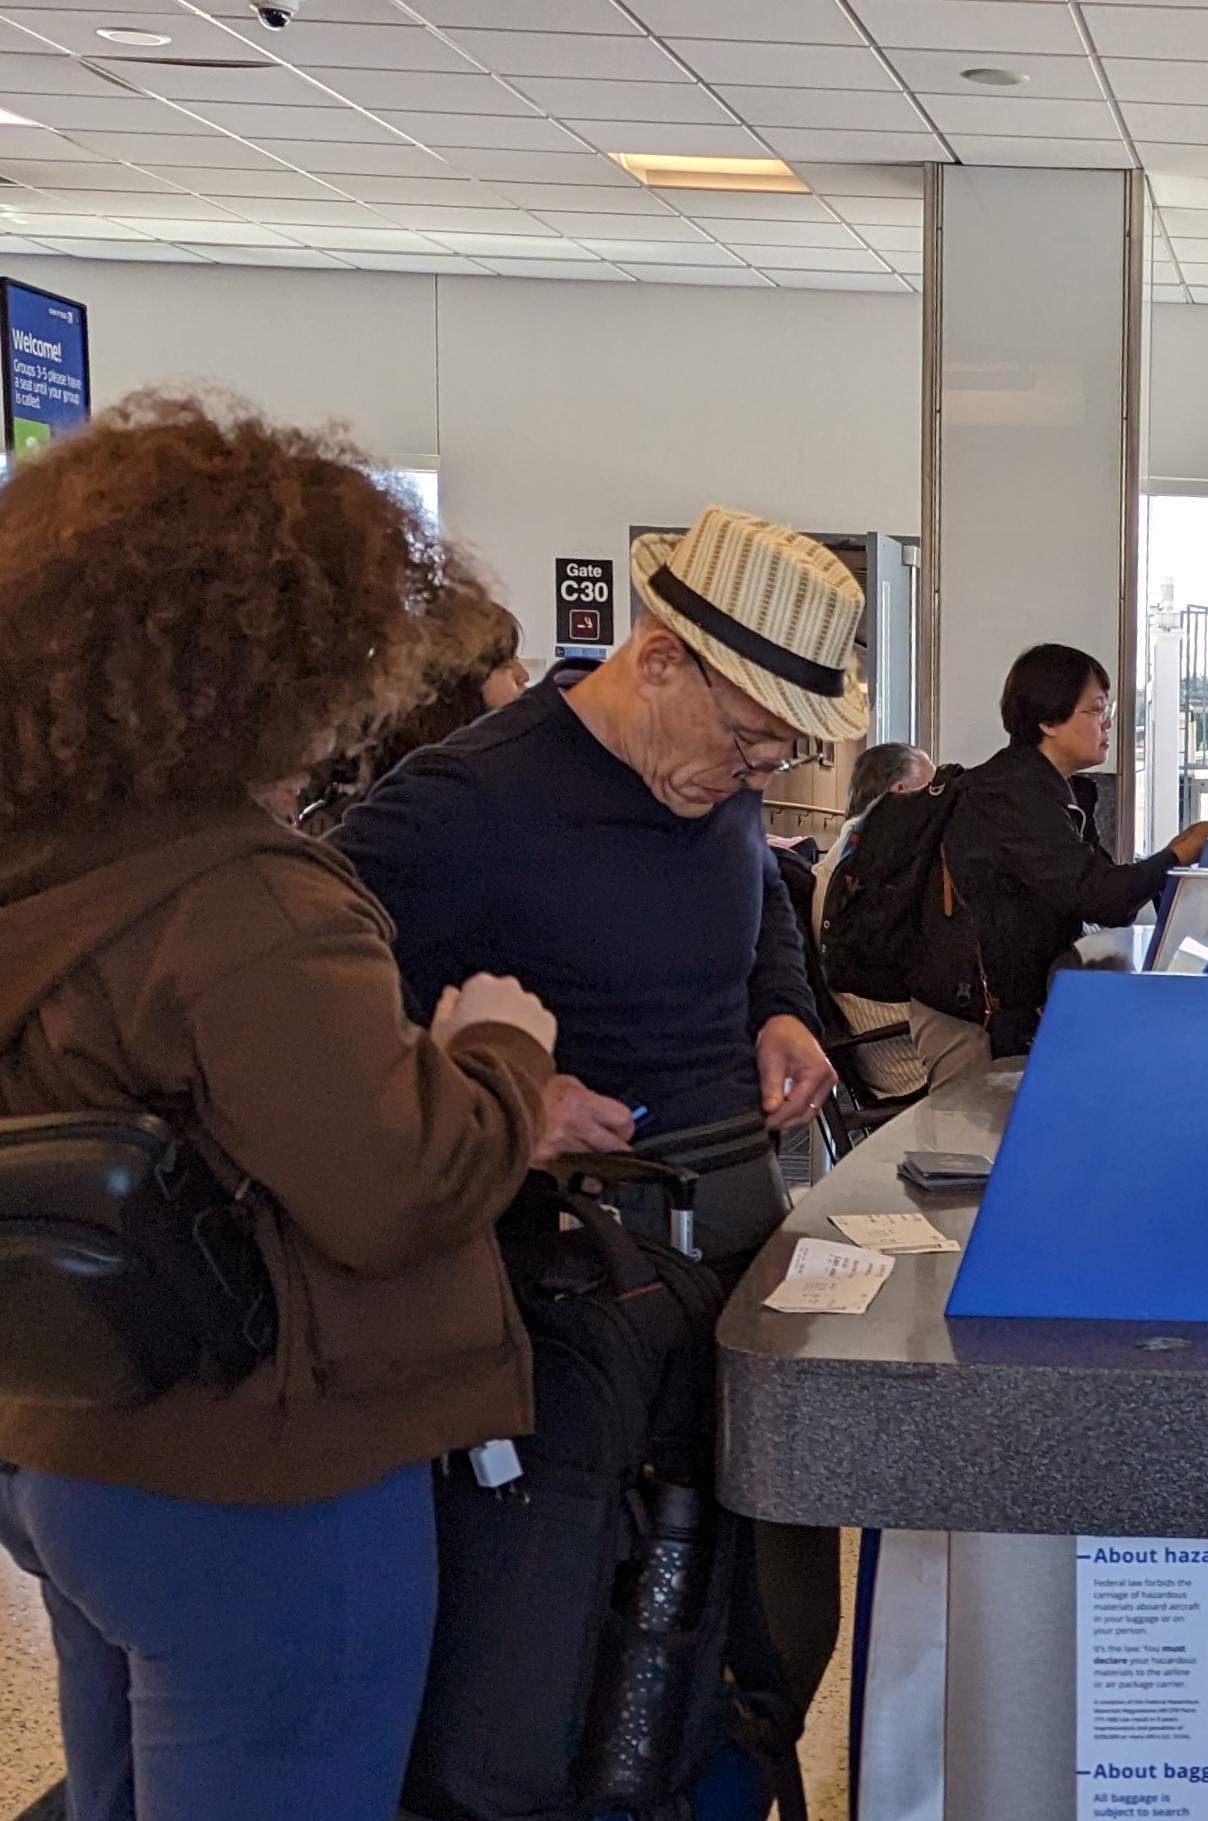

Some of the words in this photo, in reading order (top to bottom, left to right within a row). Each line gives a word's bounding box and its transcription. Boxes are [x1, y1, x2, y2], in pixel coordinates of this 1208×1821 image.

[12, 328, 62, 363] Welcome!
[14, 359, 36, 377] Groups
[36, 364, 48, 380] 3-5
[48, 369, 67, 386] please
[68, 375, 82, 390] have
[15, 377, 19, 387] a
[20, 378, 33, 392] seat
[33, 382, 48, 395] until
[49, 386, 62, 400] your
[63, 389, 80, 404] group
[16, 390, 21, 403] is
[22, 393, 41, 408] called.
[567, 563, 602, 577] Gate
[561, 580, 609, 602] C30
[1093, 1547, 1158, 1564] About
[1094, 1763, 1157, 1779] About
[1094, 1793, 1107, 1802] All
[1111, 1793, 1158, 1805] baggage
[1161, 1793, 1170, 1802] is
[1094, 1808, 1134, 1819] subject
[1138, 1809, 1150, 1817] to
[1153, 1807, 1190, 1817] search
